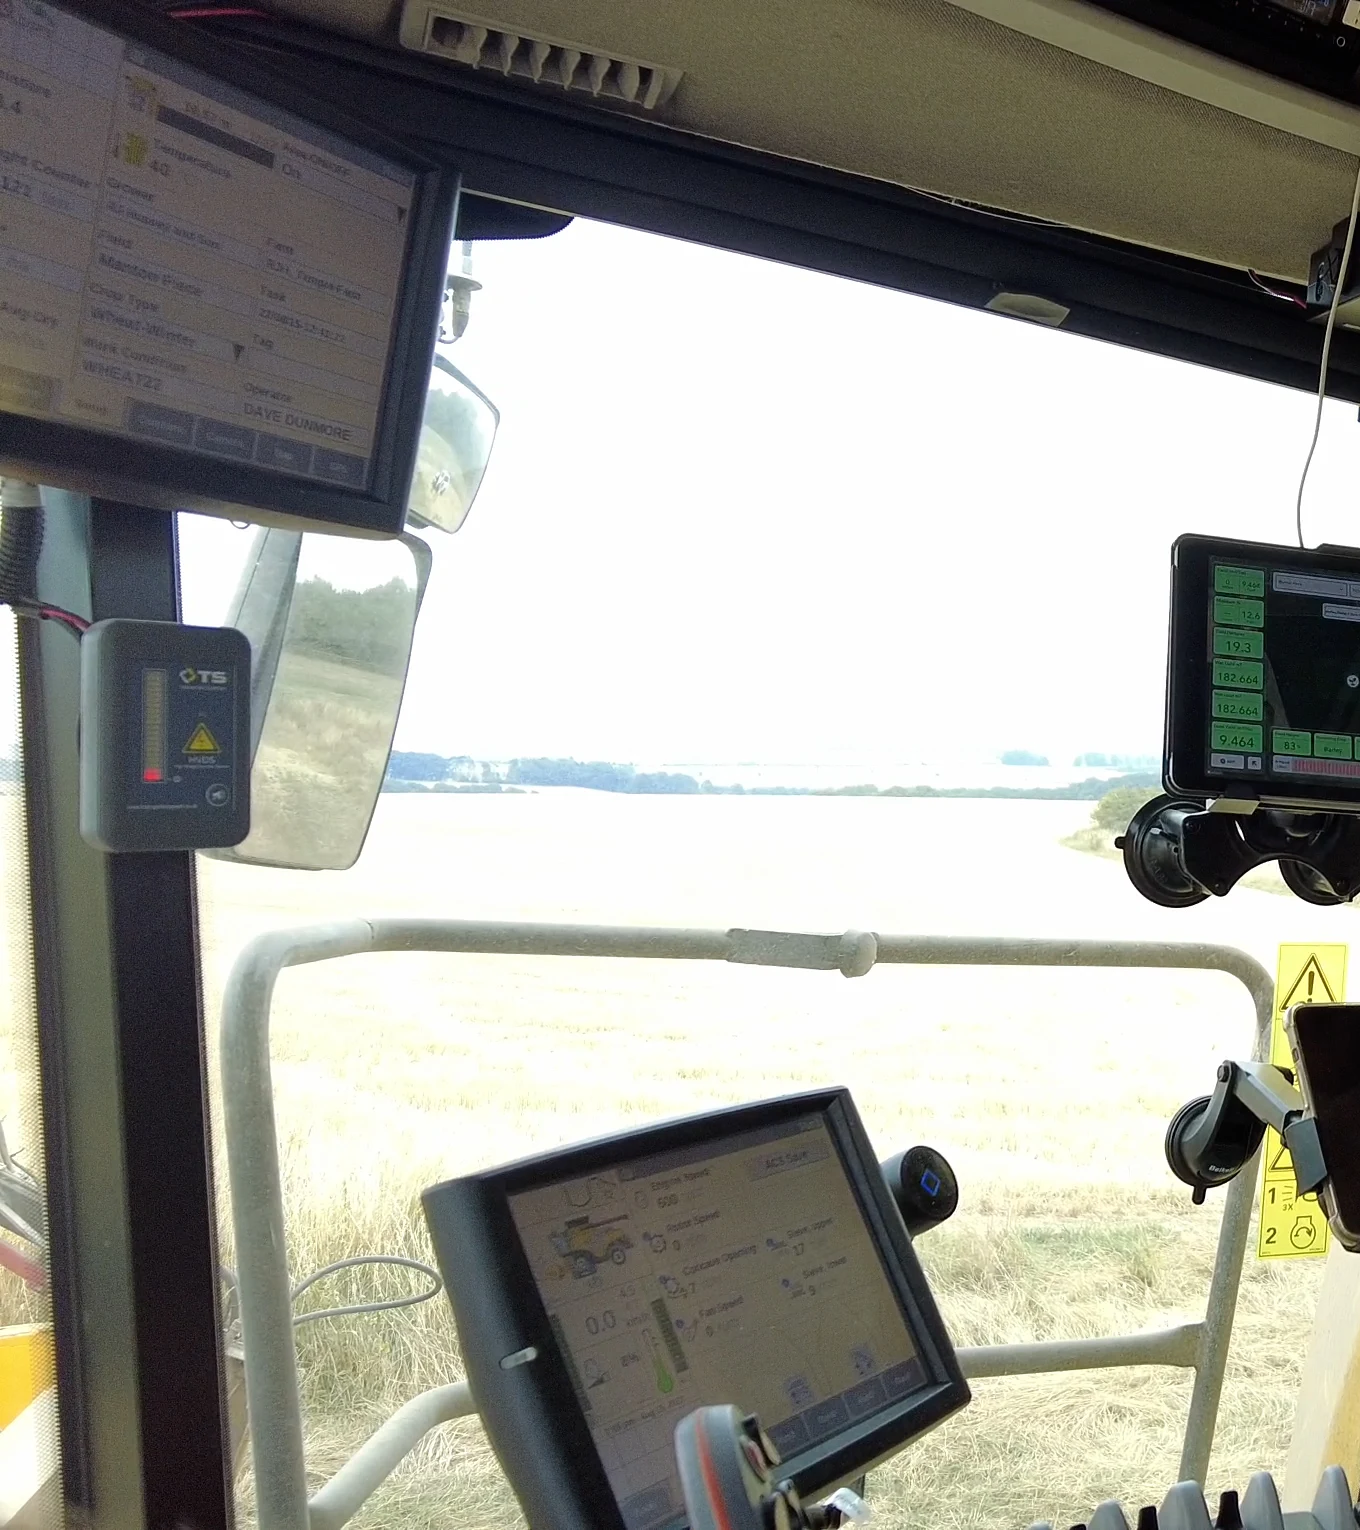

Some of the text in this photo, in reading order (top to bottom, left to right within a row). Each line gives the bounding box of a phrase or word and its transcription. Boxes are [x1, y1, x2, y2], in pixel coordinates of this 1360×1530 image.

[281, 163, 302, 180] On
[128, 294, 160, 312] Type
[83, 360, 163, 391] WHEAT22
[243, 401, 354, 442] DAVE DUNMORE
[1241, 611, 1261, 620] 12.6
[1225, 640, 1252, 653] 19.3
[1218, 672, 1259, 685] 182.664
[1217, 703, 1259, 717] 182.664
[1219, 734, 1255, 749] 9.464
[1268, 1187, 1276, 1205] 1
[1282, 1203, 1294, 1211] 3X
[693, 1210, 720, 1225] Speed
[1265, 1227, 1277, 1245] 2
[721, 1244, 757, 1263] Opening
[792, 1242, 805, 1257] 17
[717, 1294, 744, 1312] Speed
[585, 1310, 617, 1336] 0.0
